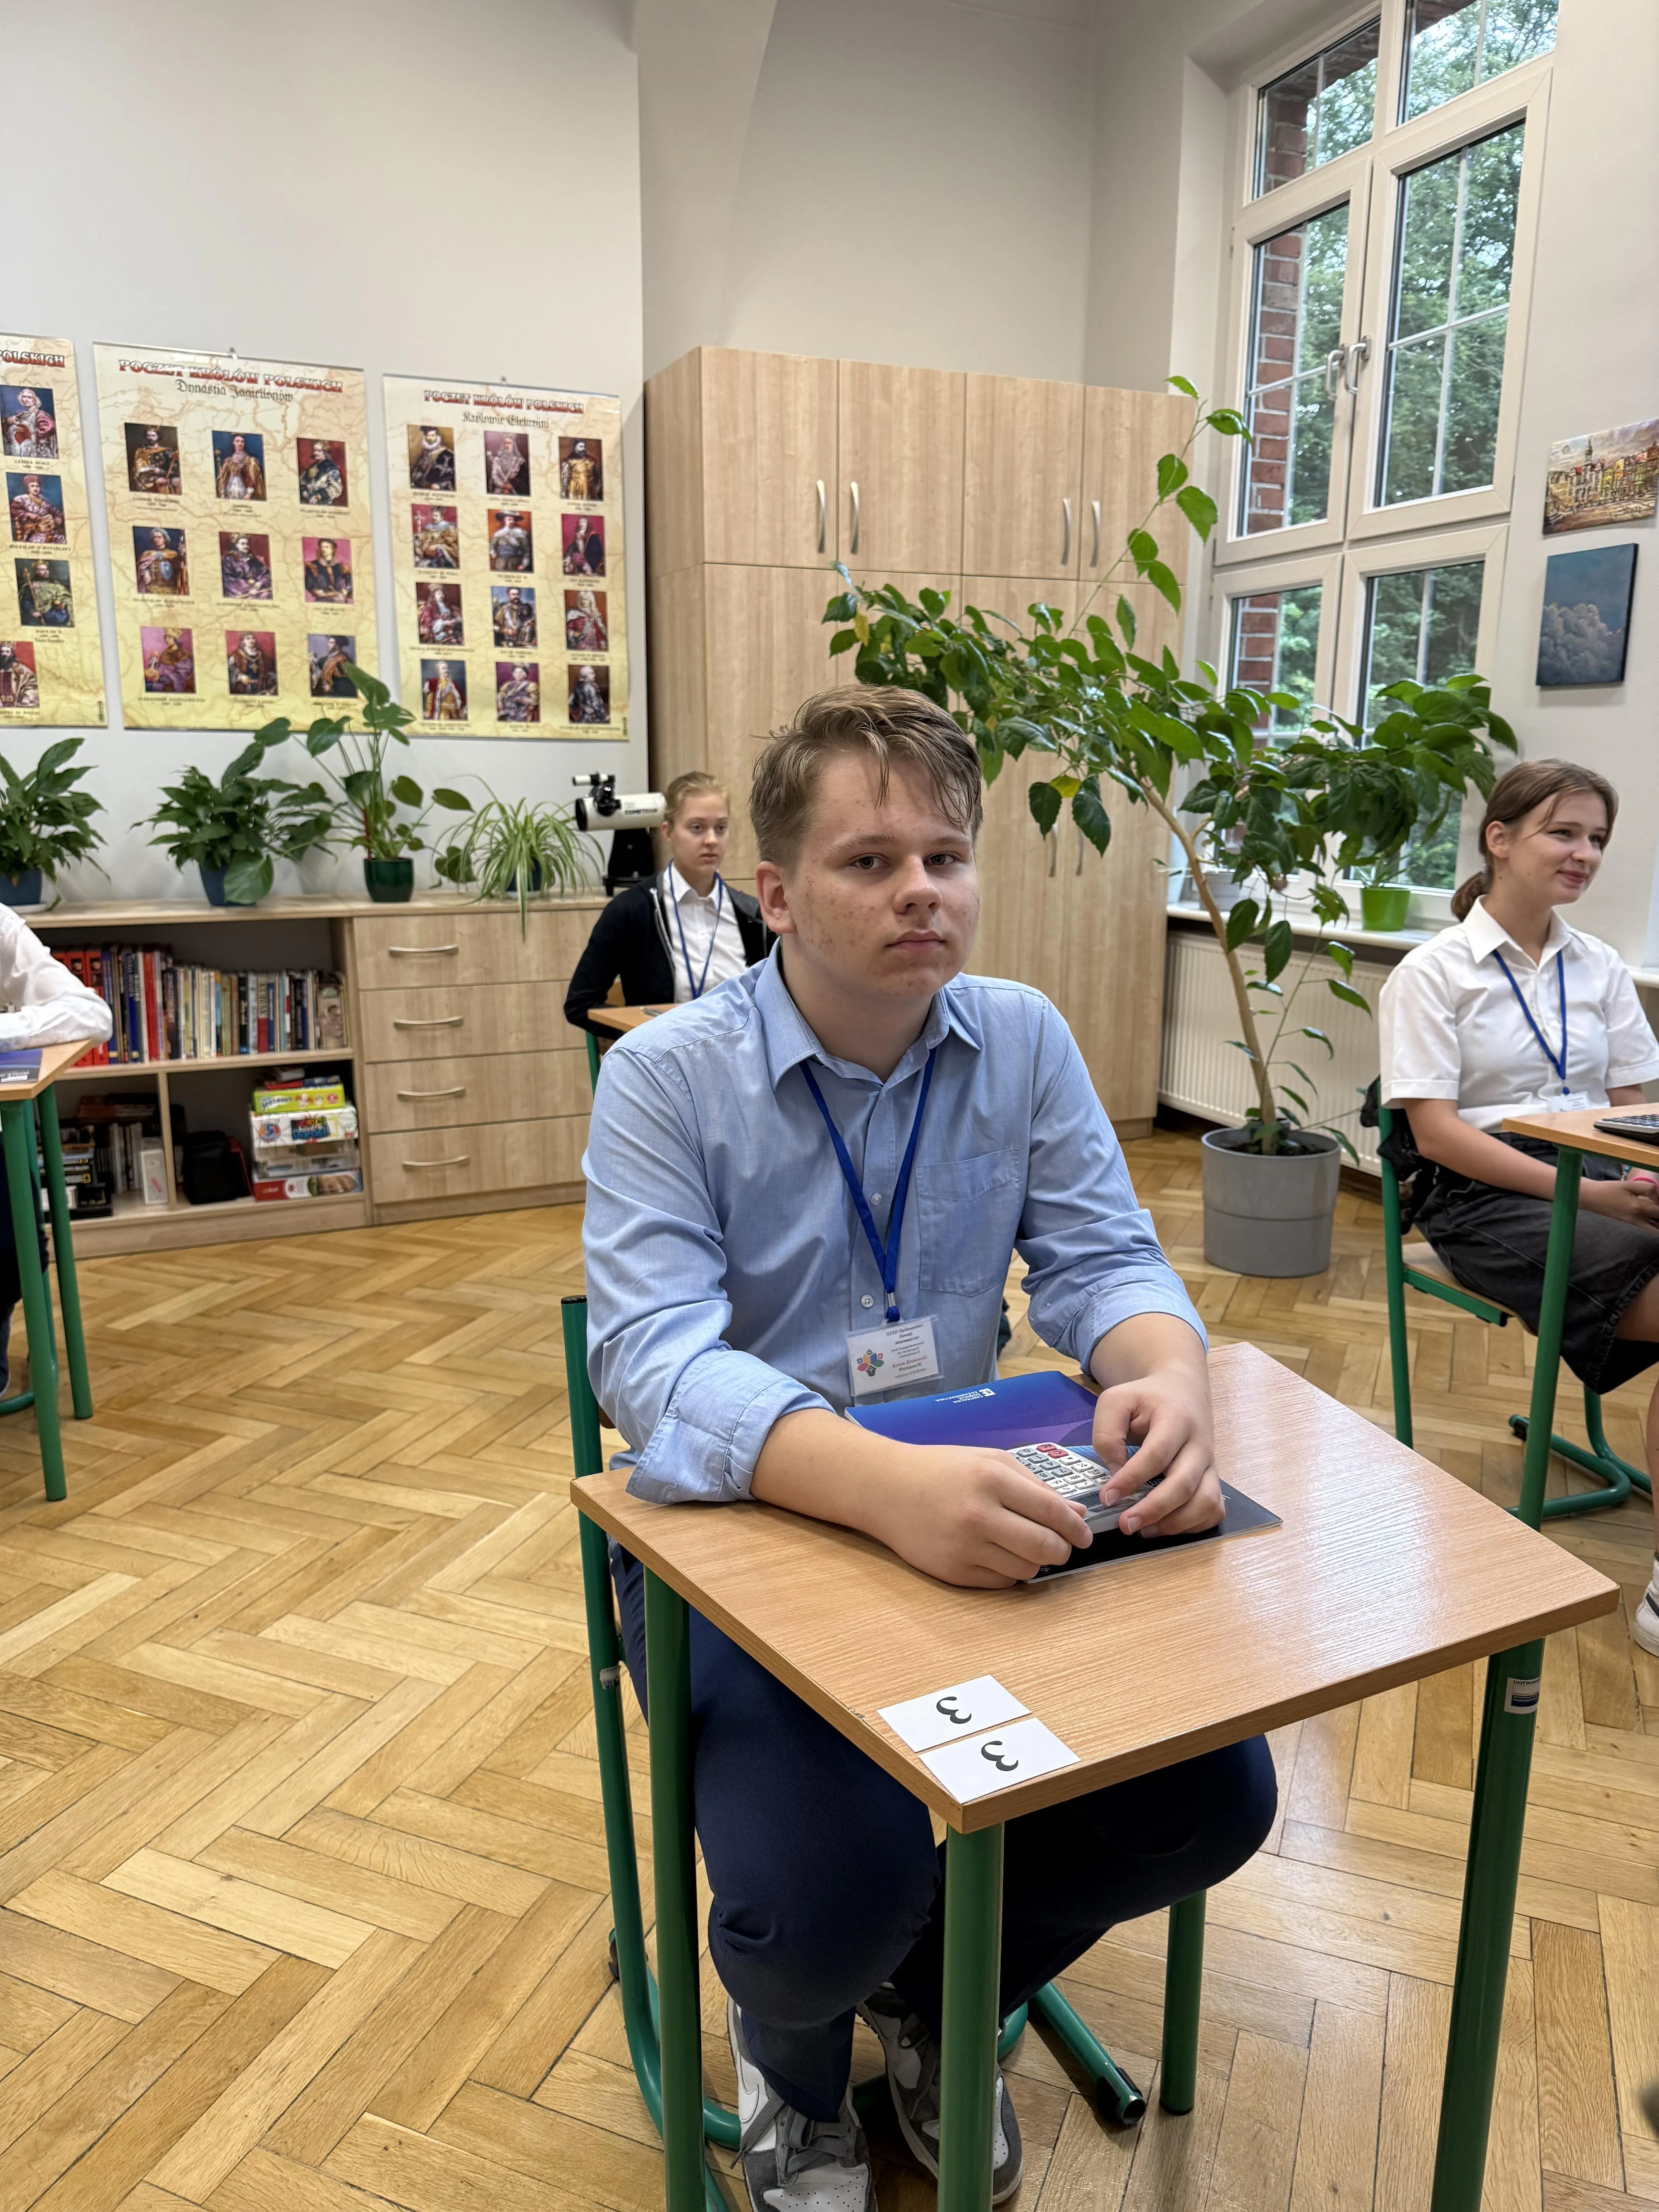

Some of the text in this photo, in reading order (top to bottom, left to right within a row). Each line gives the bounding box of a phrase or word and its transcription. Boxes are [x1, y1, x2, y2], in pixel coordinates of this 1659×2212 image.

[0, 350, 65, 367] OLSKICH
[119, 359, 343, 393] POCZET KRÓLÓW POLSKICH
[175, 379, 227, 395] Dynastia
[424, 390, 584, 414] POCZET KRÓLÓW POLSKICH
[936, 1696, 972, 1724] 3
[981, 1740, 1019, 1772] 3
